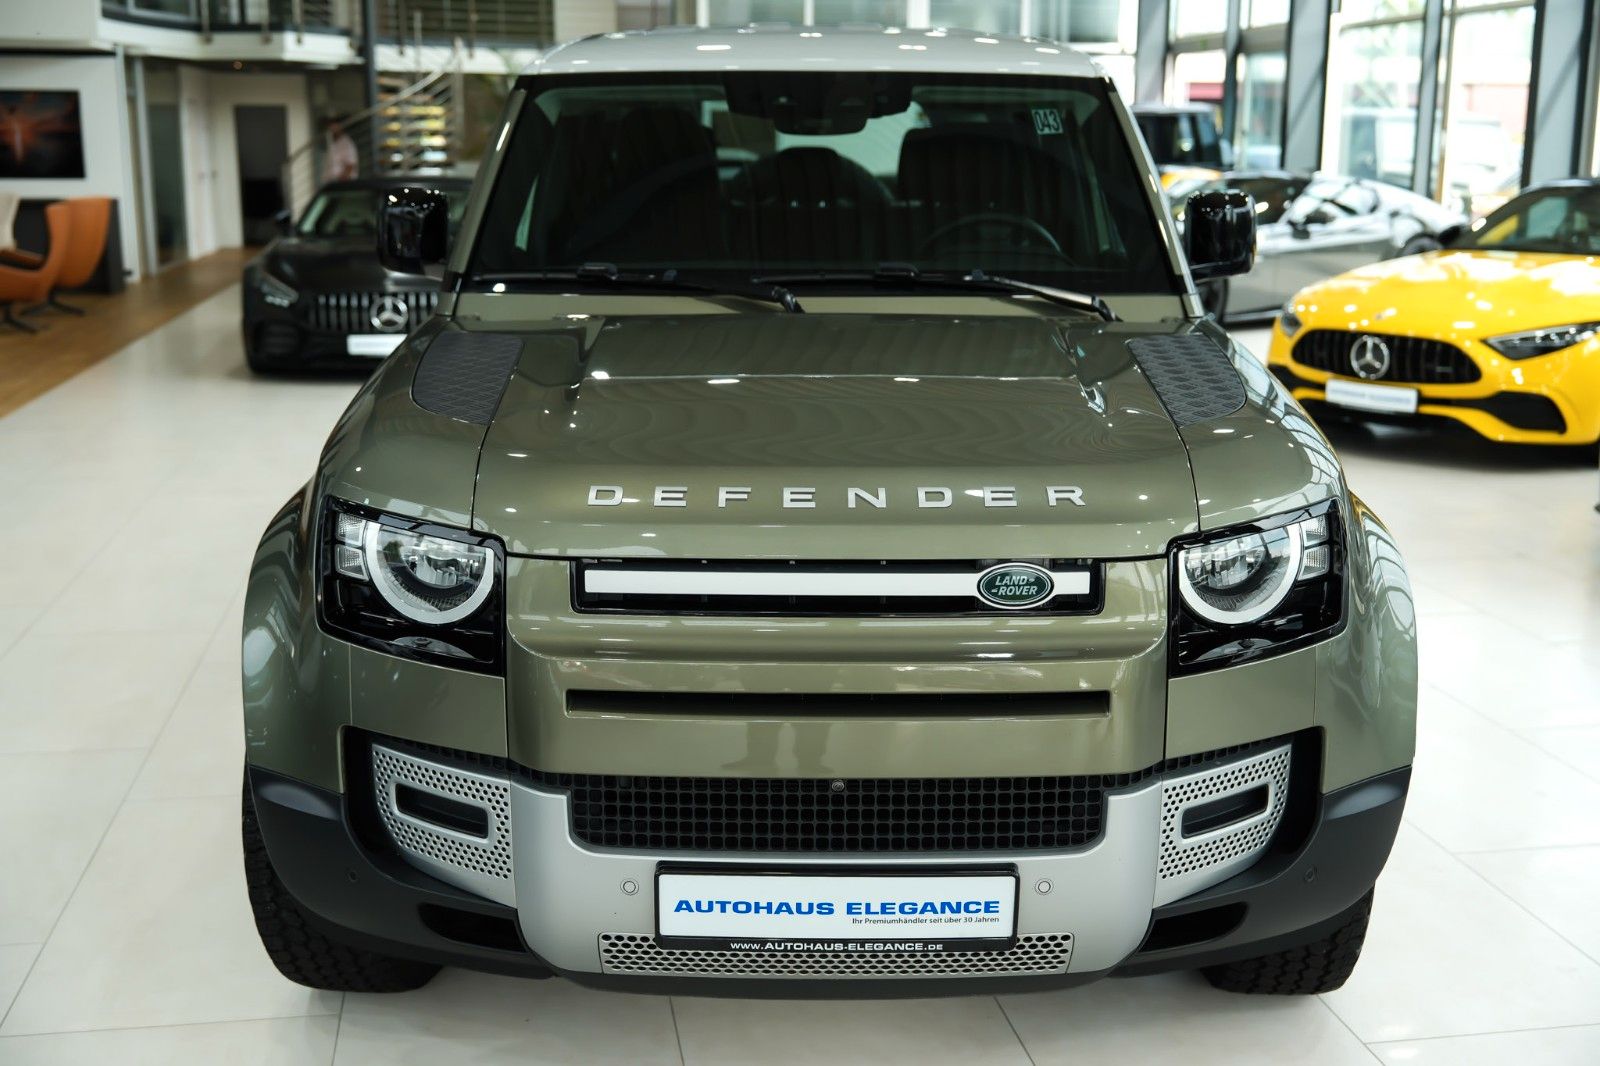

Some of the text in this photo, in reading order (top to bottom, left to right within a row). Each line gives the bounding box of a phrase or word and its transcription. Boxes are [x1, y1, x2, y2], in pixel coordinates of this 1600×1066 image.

[1034, 111, 1060, 132] 043
[588, 485, 1086, 508] DEFENDER
[995, 575, 1028, 586] LAND
[998, 586, 1038, 596] ROVER
[673, 900, 1000, 916] AUTOHAUS ELEGANCE
[944, 916, 961, 924] über
